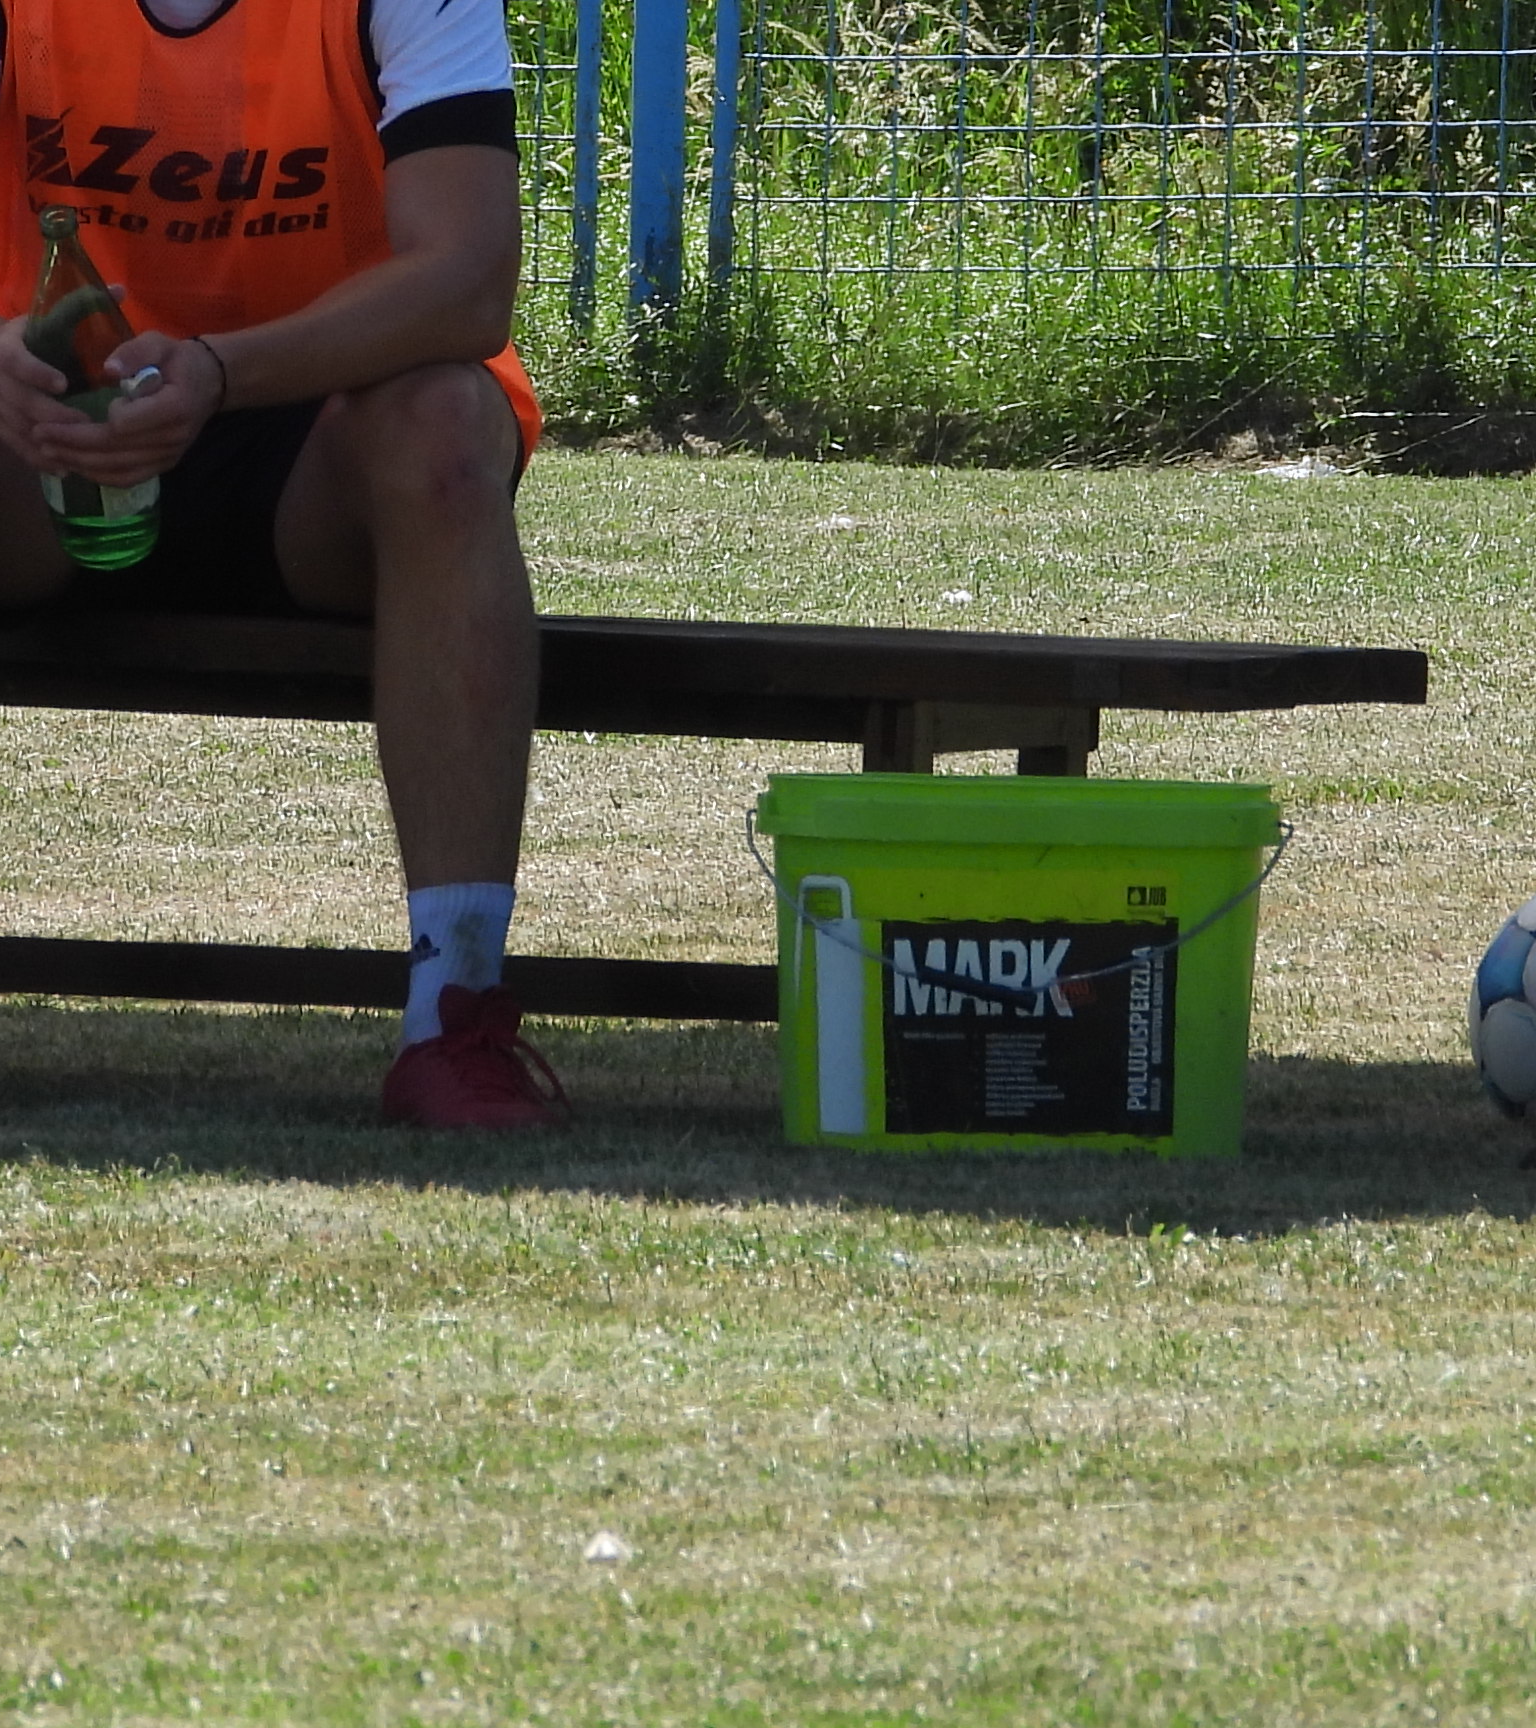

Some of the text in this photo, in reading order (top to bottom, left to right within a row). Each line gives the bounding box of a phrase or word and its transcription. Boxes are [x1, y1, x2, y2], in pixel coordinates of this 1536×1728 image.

[72, 125, 329, 202] Zeus
[243, 203, 330, 238] dei
[894, 938, 1073, 1017] MARK
